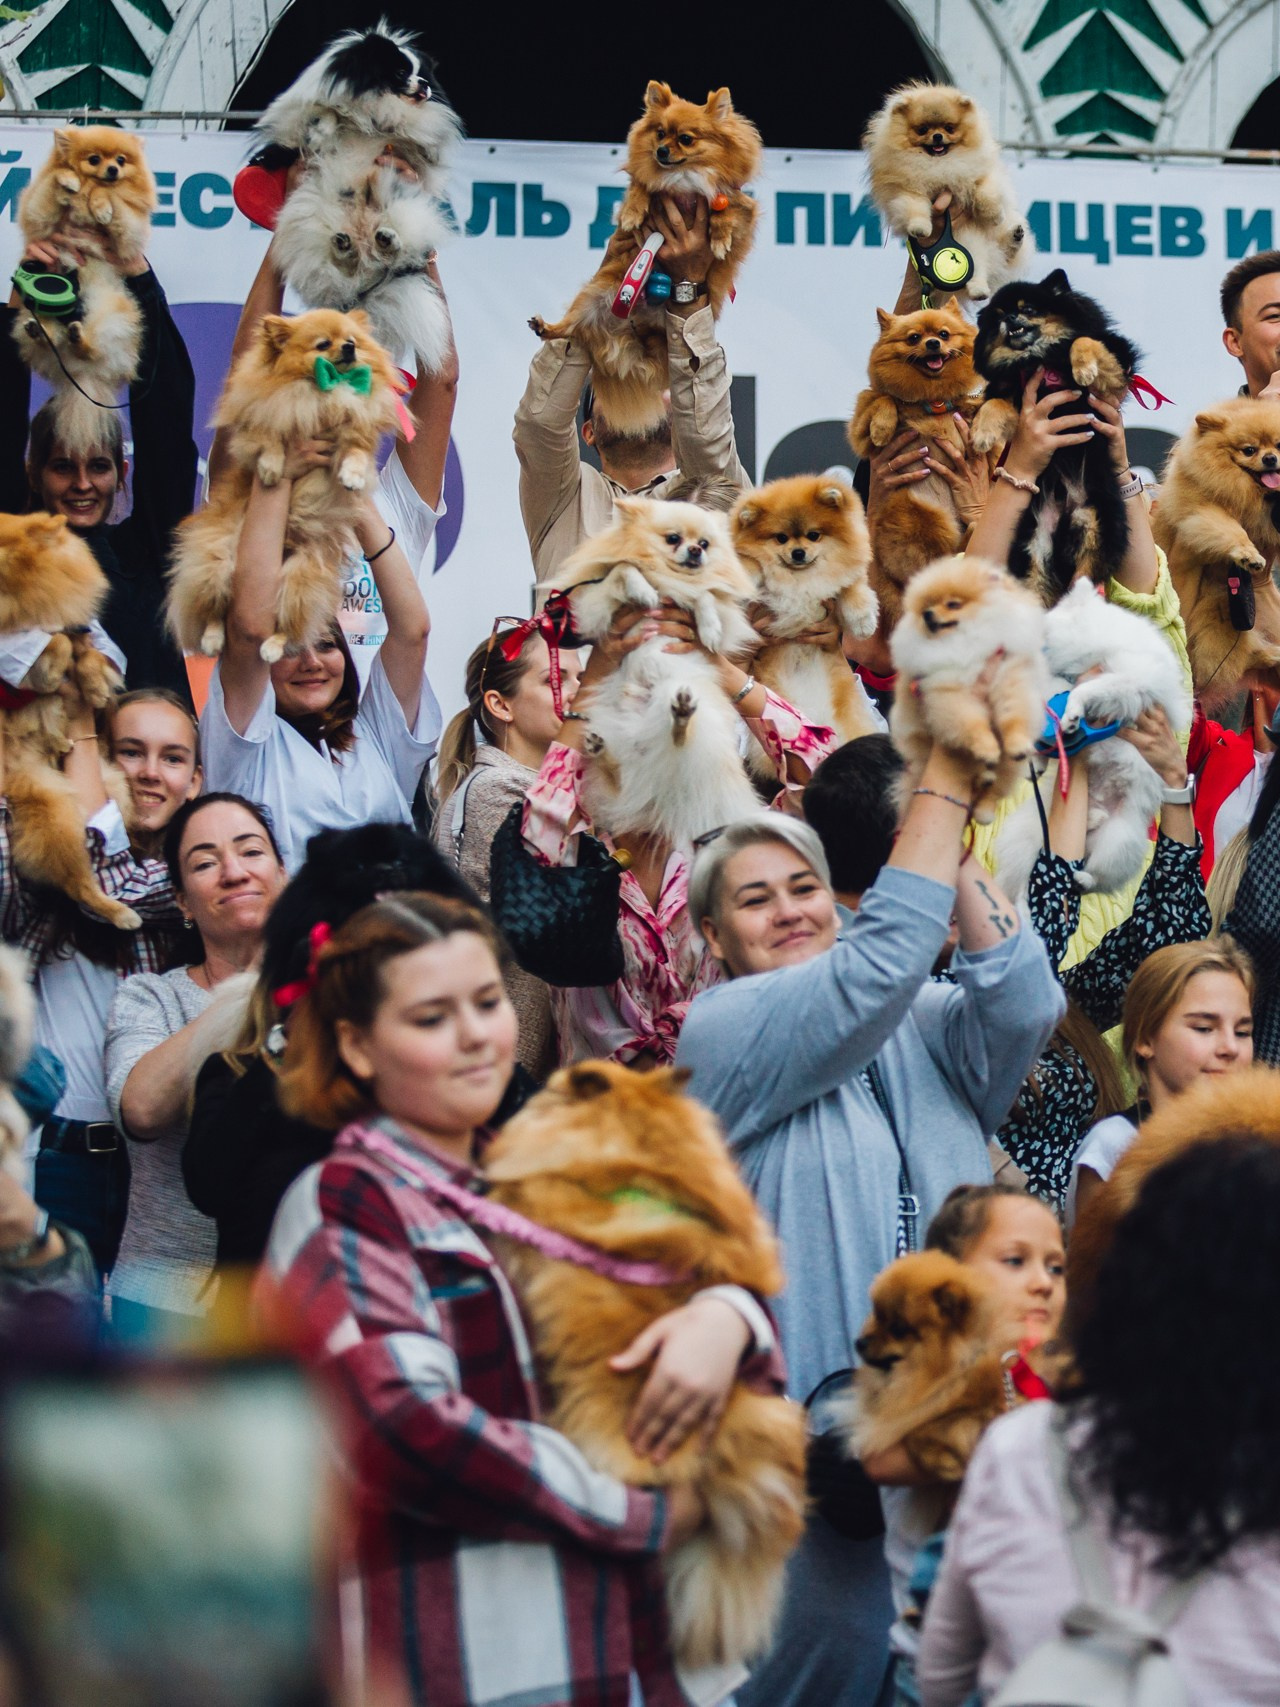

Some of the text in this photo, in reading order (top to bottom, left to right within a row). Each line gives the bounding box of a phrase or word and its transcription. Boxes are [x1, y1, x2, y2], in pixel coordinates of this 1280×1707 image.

[775, 191, 1207, 265] ПИЦЕВ
[1225, 208, 1273, 259] И
[341, 598, 384, 613] AWES
